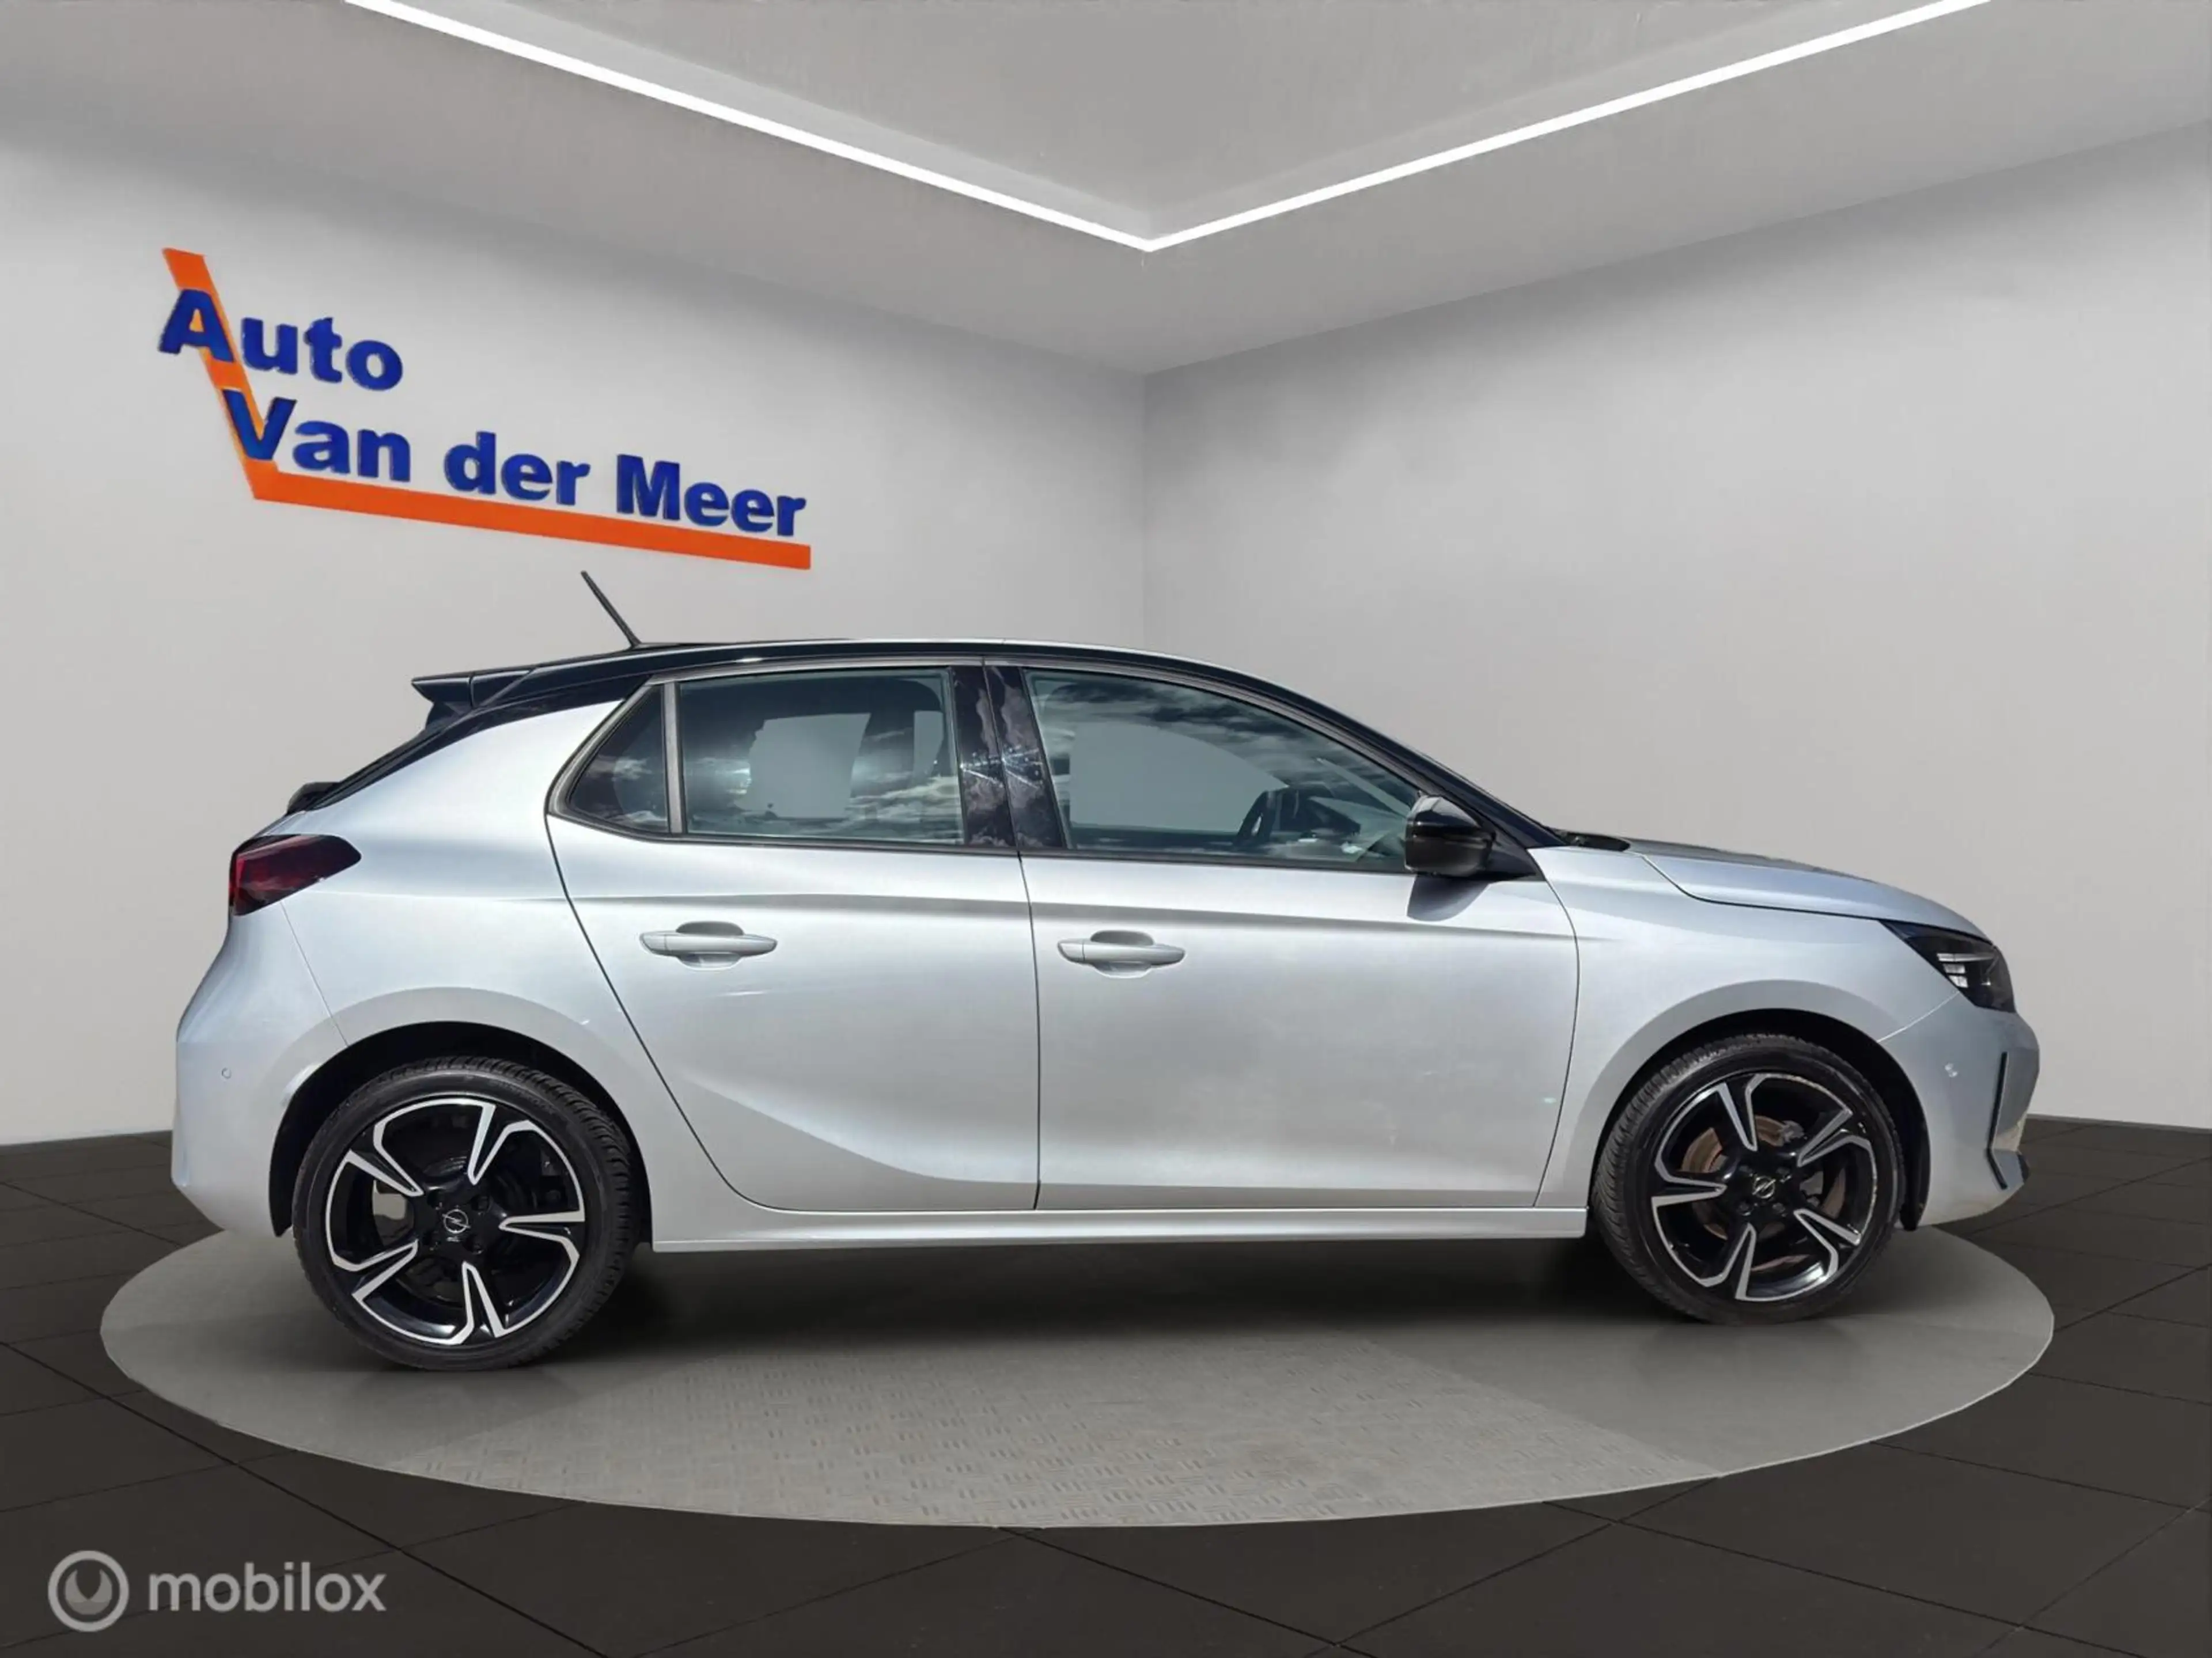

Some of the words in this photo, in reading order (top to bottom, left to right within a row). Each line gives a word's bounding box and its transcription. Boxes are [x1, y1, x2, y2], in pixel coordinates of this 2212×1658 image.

[158, 289, 403, 390] Auto
[223, 389, 411, 481] Van
[444, 431, 590, 506] der
[616, 454, 806, 536] Meer
